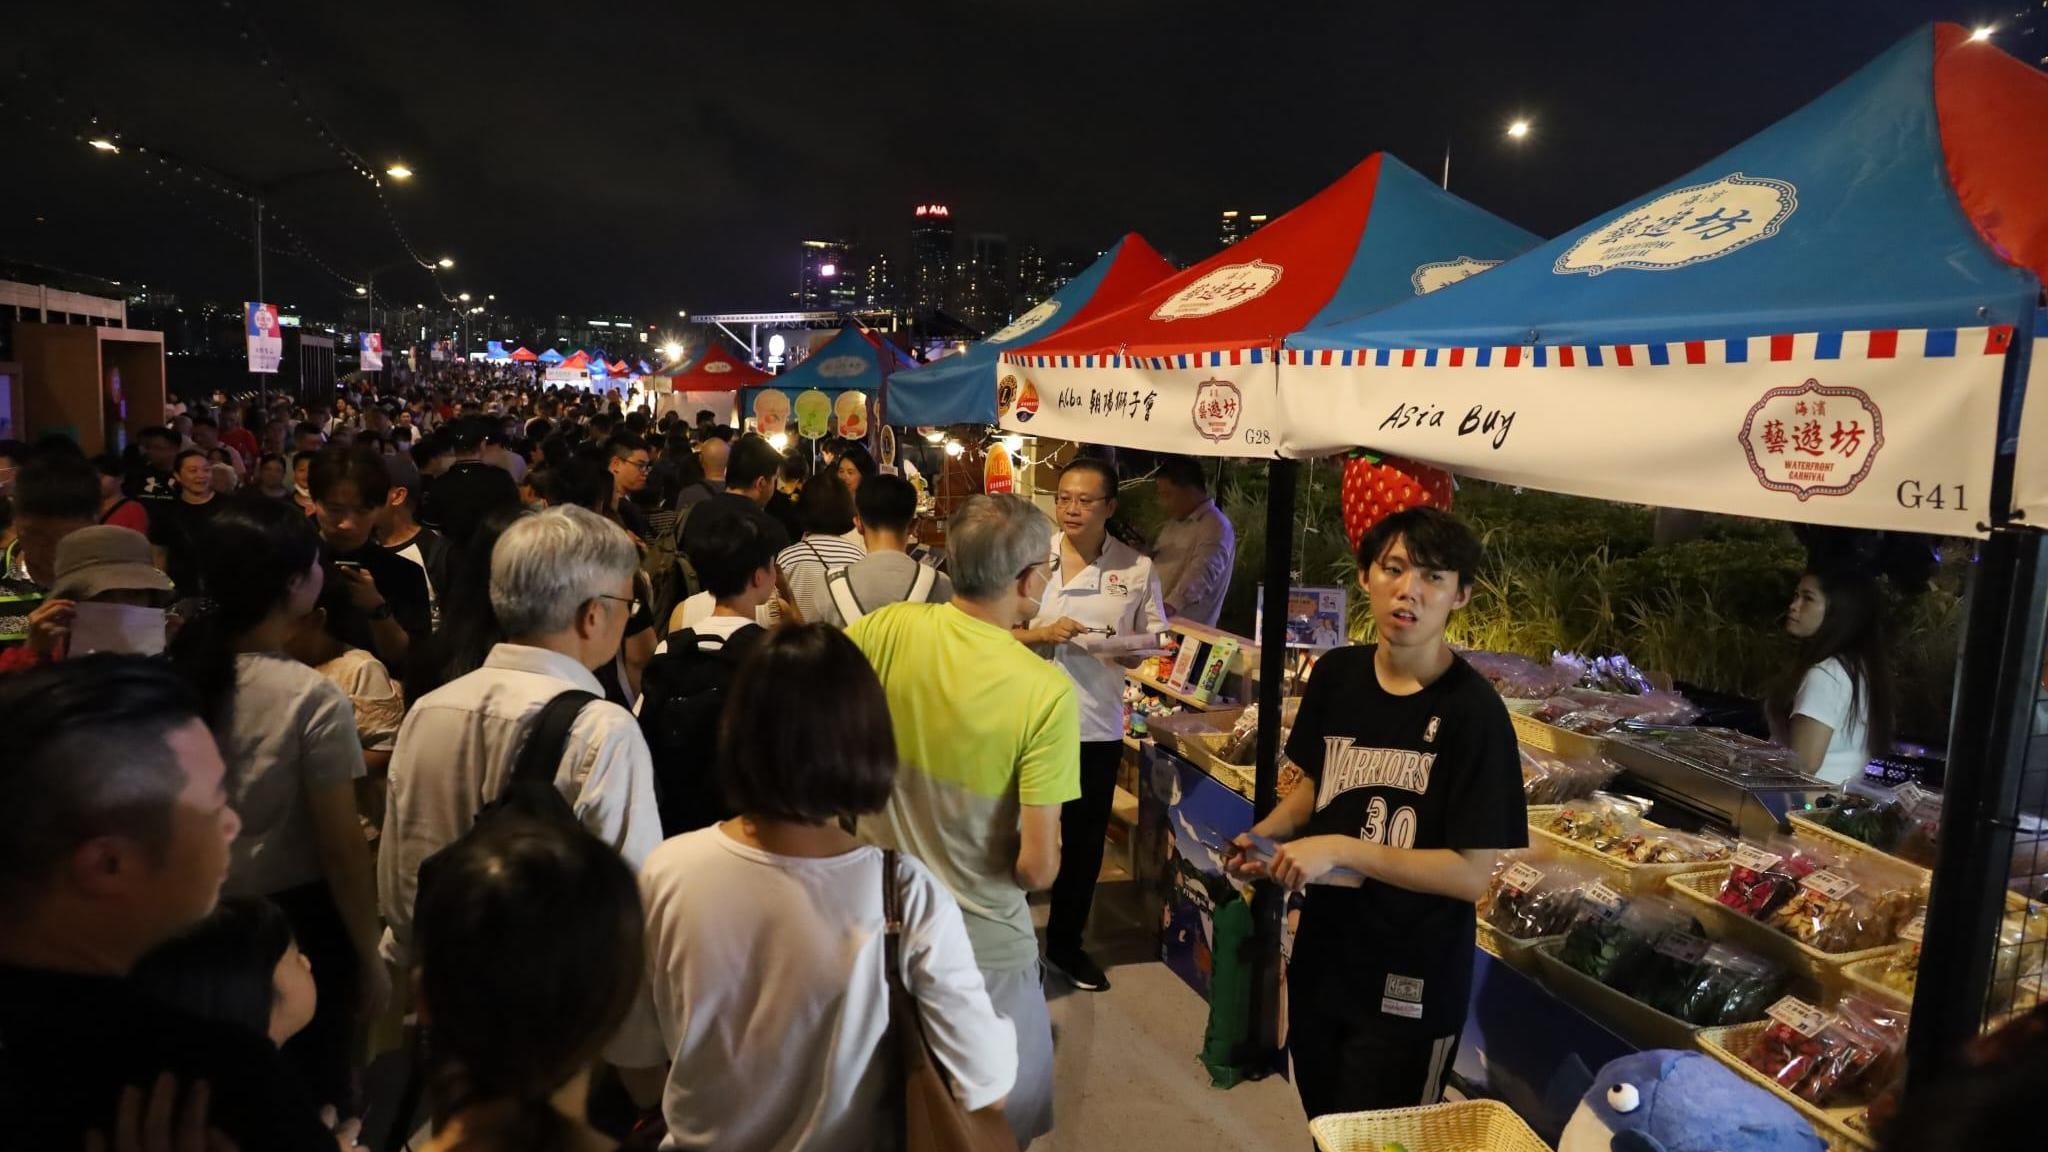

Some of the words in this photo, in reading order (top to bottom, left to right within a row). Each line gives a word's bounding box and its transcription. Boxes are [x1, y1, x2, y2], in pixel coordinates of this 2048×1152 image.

[929, 204, 948, 216] AIA
[1058, 387, 1082, 408] Alba
[1378, 402, 1445, 431] Asia
[1795, 400, 1826, 417] 海濱
[1245, 428, 1271, 445] G28
[1784, 461, 1835, 473] WATERFRONT
[1788, 470, 1825, 482] CARNIVAL
[1896, 479, 1969, 511] G41
[1316, 736, 1438, 813] WARRIORS
[1360, 796, 1418, 850] 30
